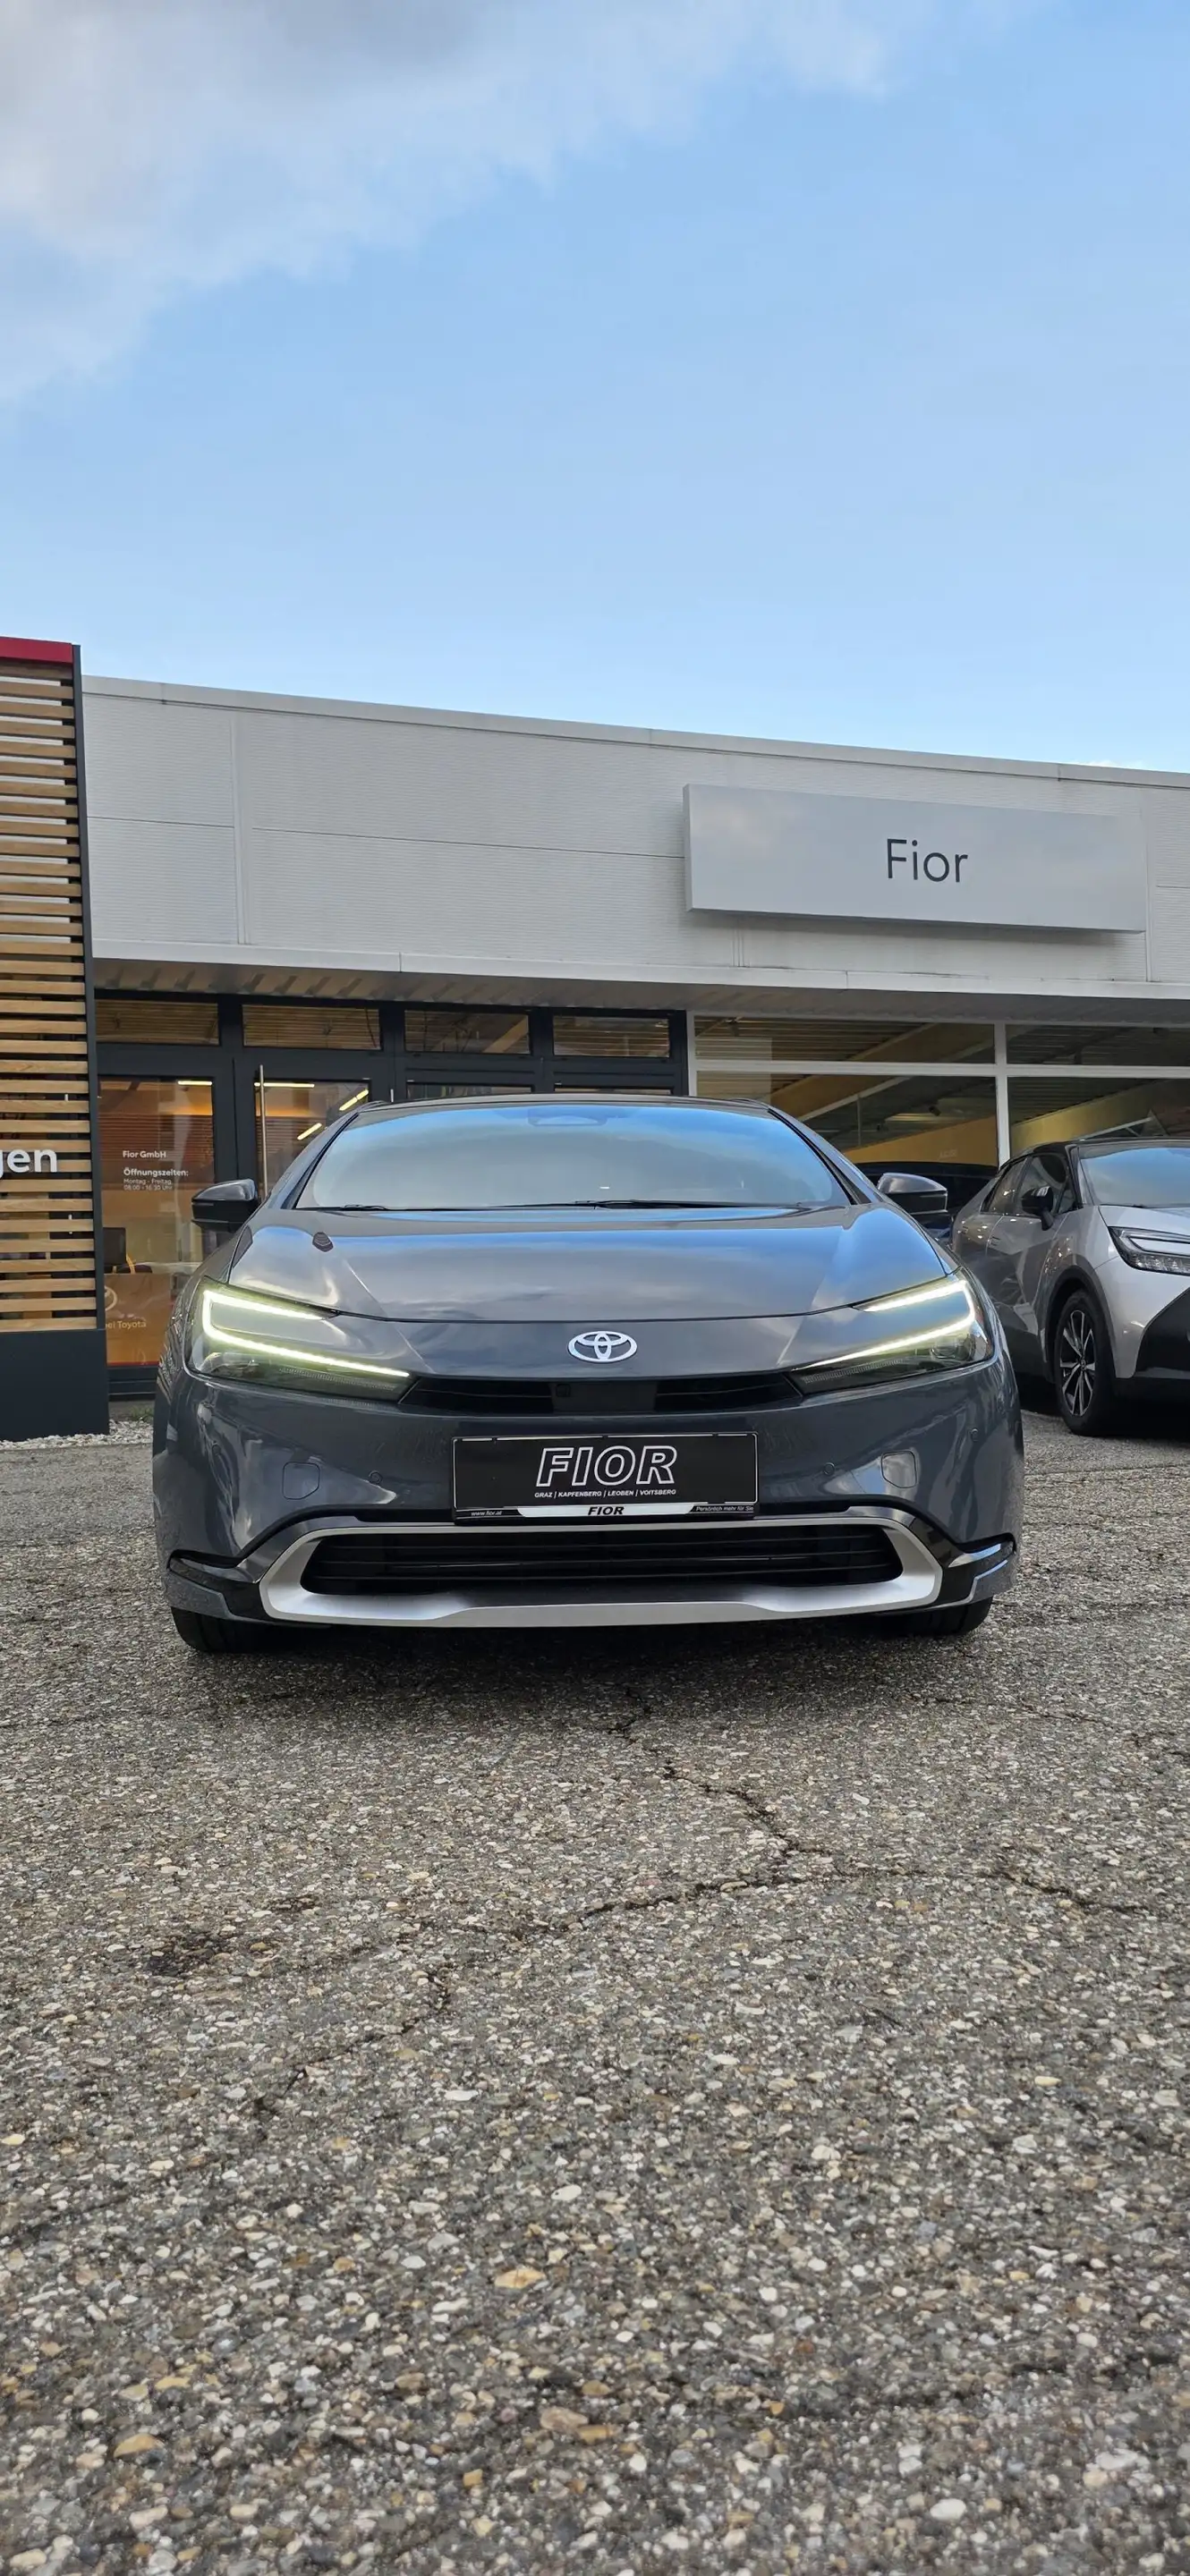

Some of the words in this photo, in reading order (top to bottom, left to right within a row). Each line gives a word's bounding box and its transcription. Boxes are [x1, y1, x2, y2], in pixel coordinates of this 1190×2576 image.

[886, 838, 968, 883] Fior
[123, 1150, 140, 1158] Fior
[140, 1150, 166, 1158] GmbH
[123, 1167, 189, 1177] Öffnungszeiten:
[106, 1320, 115, 1329] ei
[117, 1320, 147, 1330] Toyota
[536, 1445, 677, 1487] FIOR
[587, 1505, 625, 1516] FIOR
